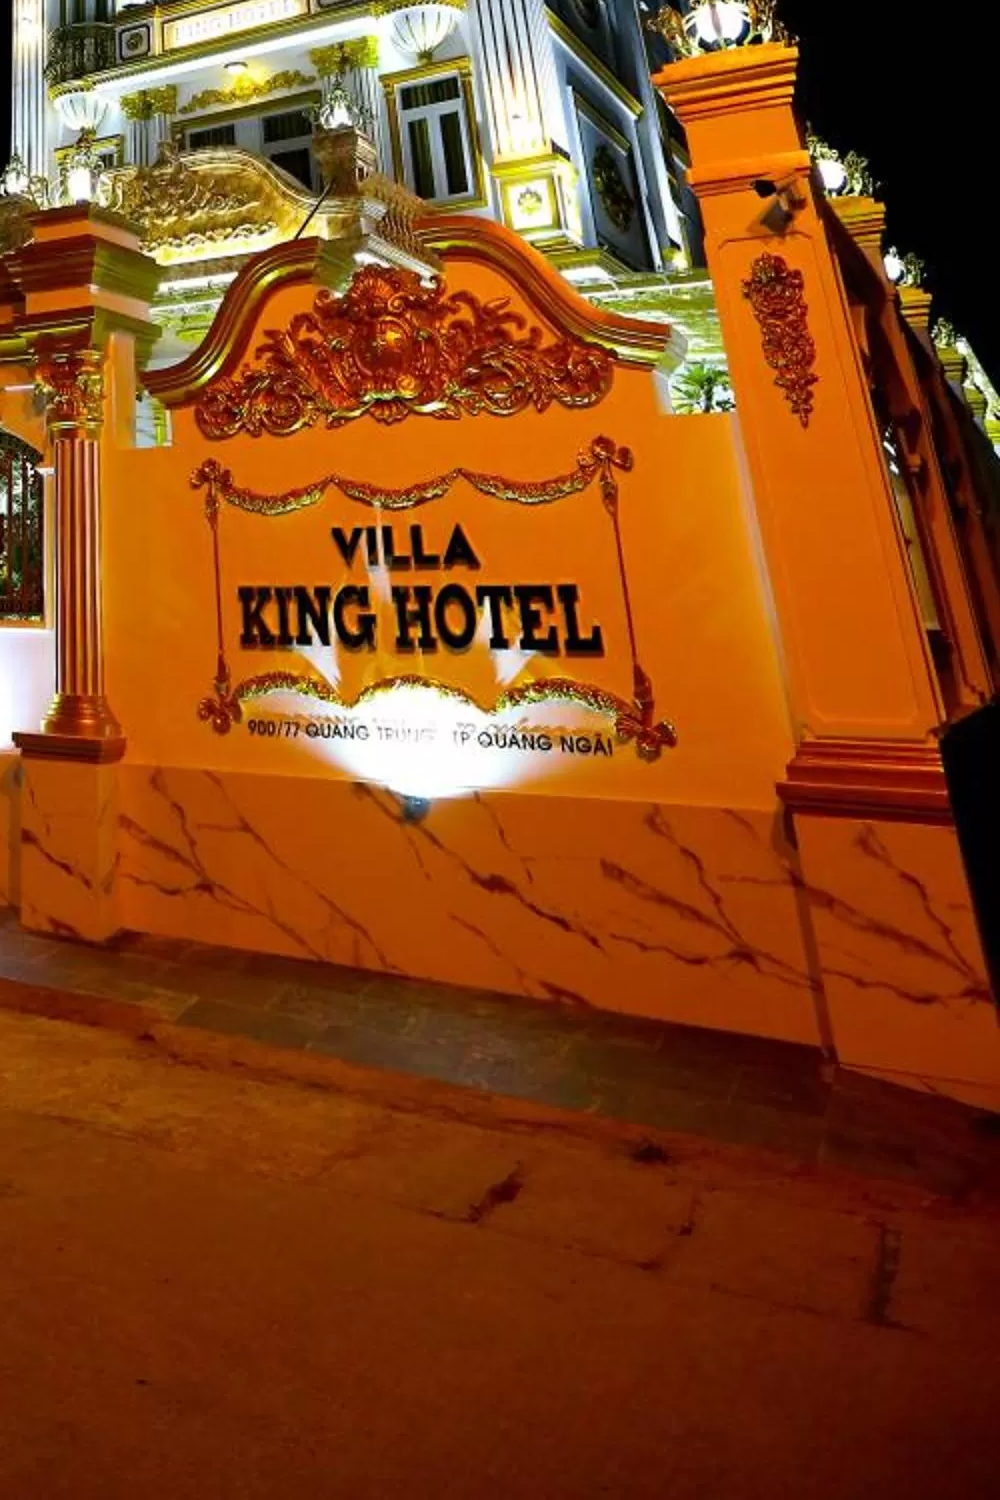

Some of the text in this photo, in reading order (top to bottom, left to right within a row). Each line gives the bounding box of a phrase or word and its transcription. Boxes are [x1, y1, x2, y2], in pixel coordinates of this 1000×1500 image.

[331, 522, 481, 571] VILLA
[237, 583, 603, 655] KING HOTEL
[304, 722, 370, 741] QUANG
